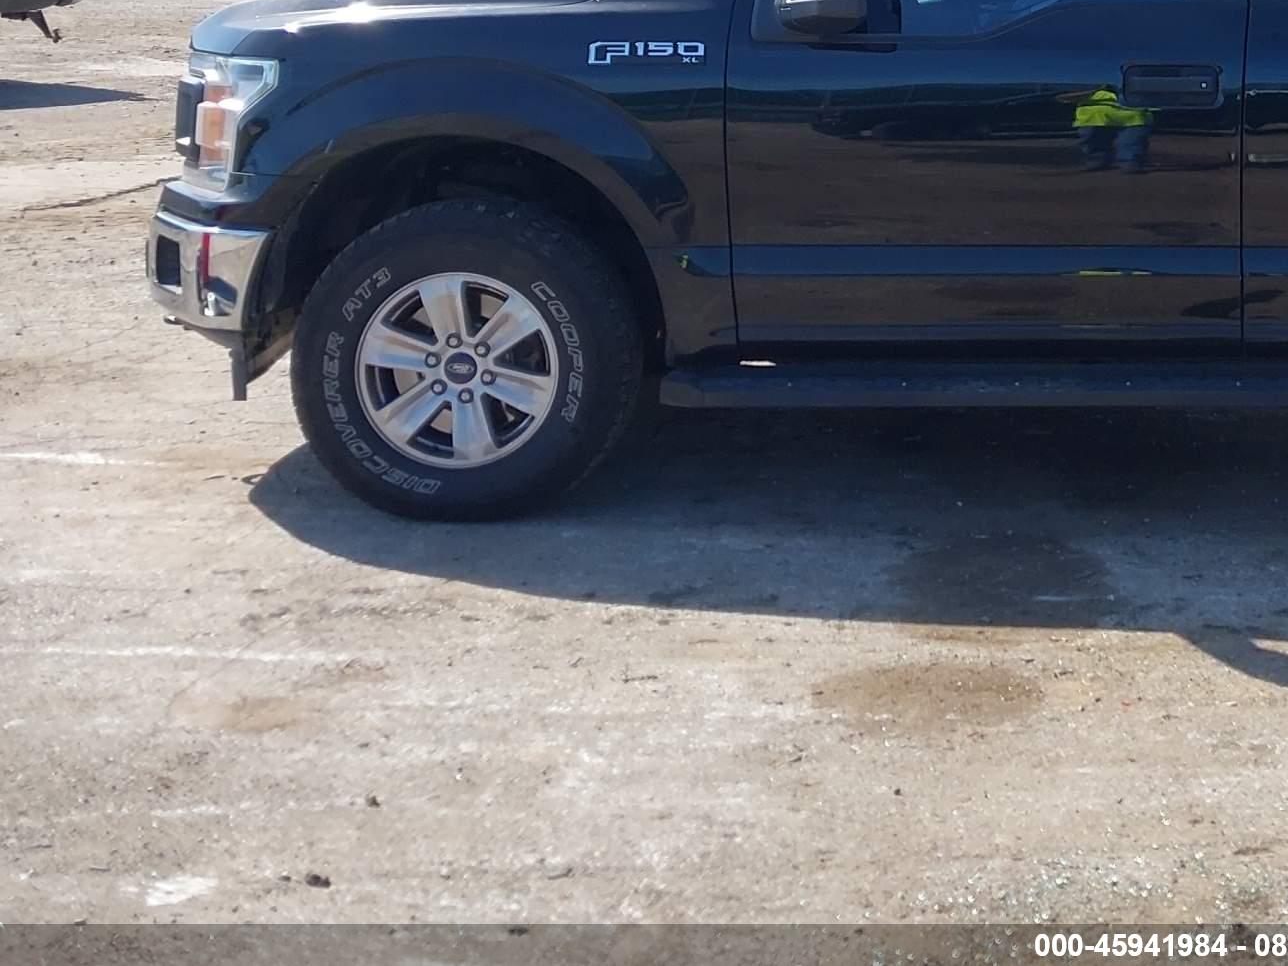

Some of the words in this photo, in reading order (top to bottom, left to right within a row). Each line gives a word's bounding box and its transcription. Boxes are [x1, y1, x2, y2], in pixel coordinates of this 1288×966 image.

[588, 41, 705, 65] F150
[682, 56, 699, 64] XL
[341, 266, 392, 322] AT3
[530, 280, 584, 423] COOPER
[322, 331, 442, 495] DISCOVERER
